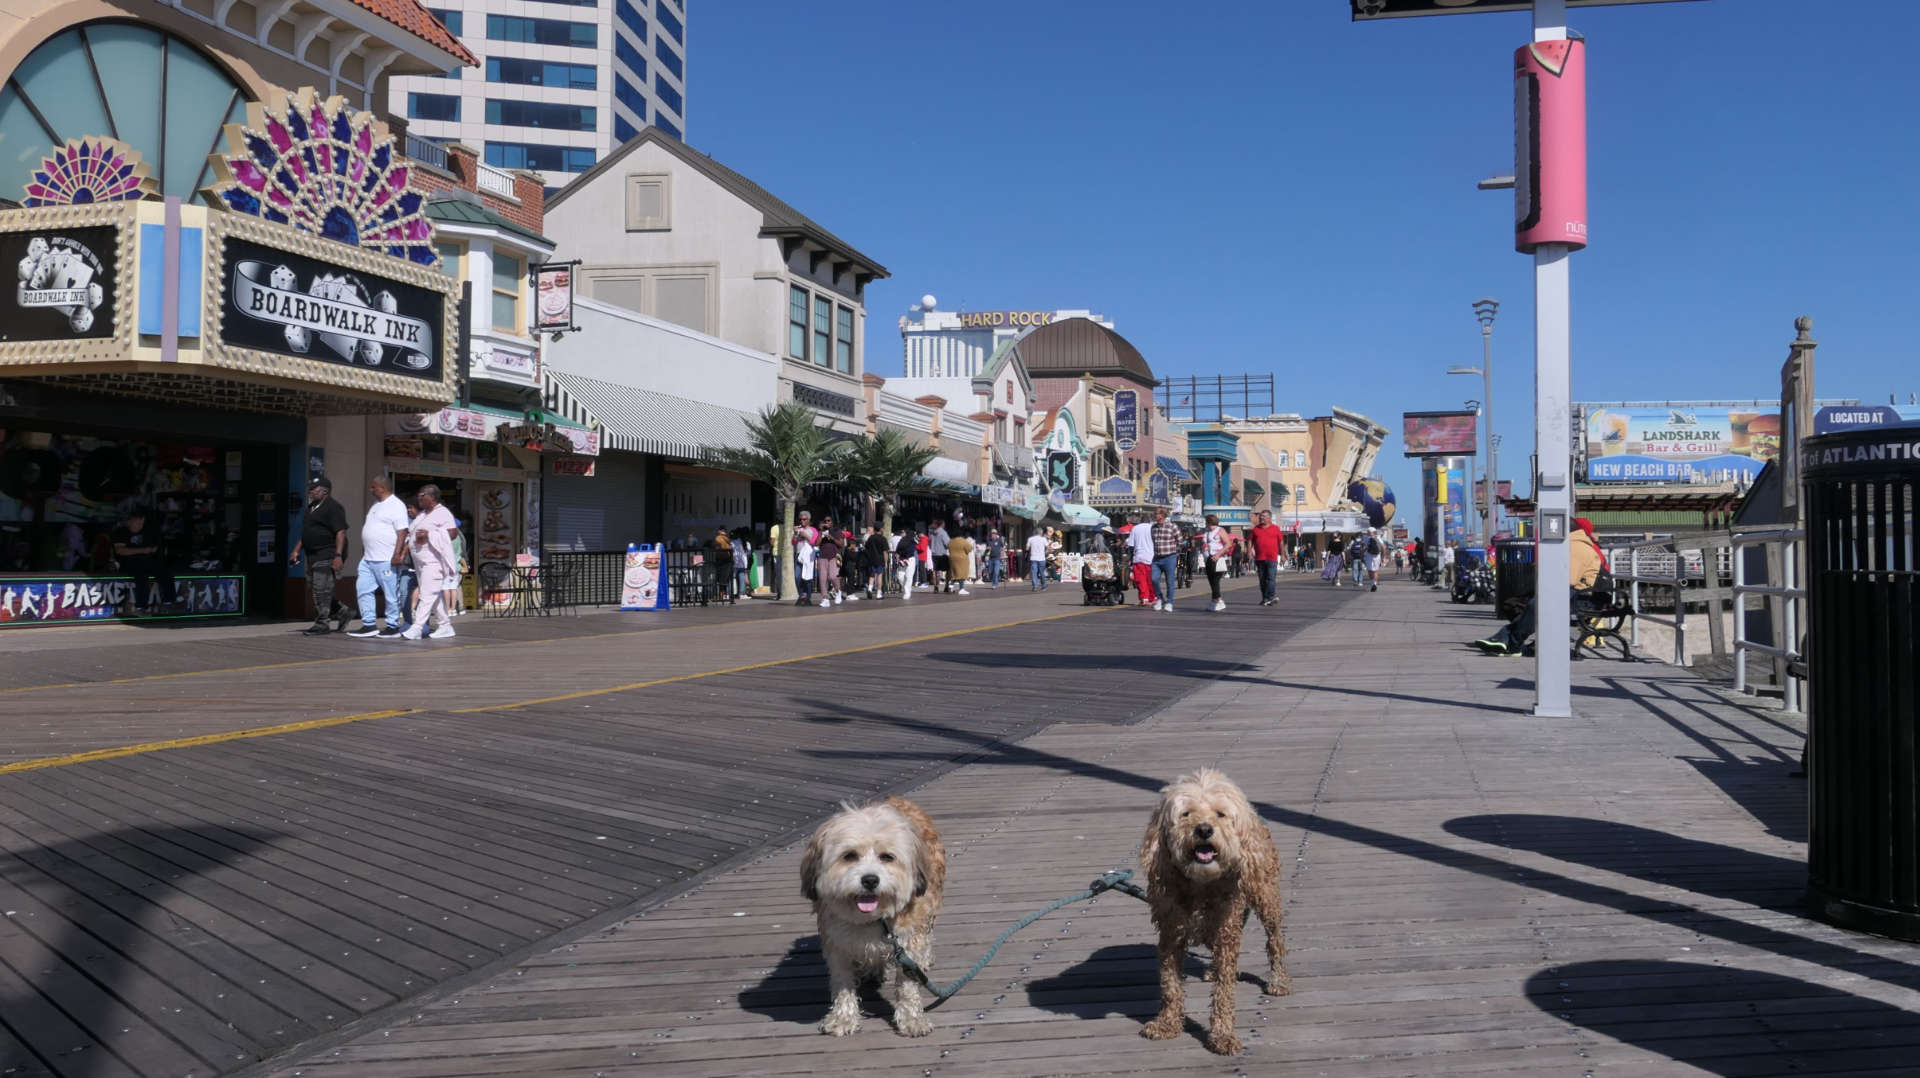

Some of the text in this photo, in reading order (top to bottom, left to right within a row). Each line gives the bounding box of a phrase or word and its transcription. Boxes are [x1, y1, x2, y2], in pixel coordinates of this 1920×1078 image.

[23, 291, 86, 304] BOARDWALK INK
[250, 287, 377, 335] BOARDWALK
[385, 318, 421, 343] INK
[961, 311, 1051, 327] HARD ROCK
[1830, 412, 1884, 424] LOCATED AT
[1643, 430, 1720, 441] LANDSHARK
[1647, 443, 1718, 453] Bar & Grill
[1809, 450, 1820, 466] of
[554, 459, 593, 473] PIZZA
[1594, 463, 1693, 477] NEW BEACH BAR
